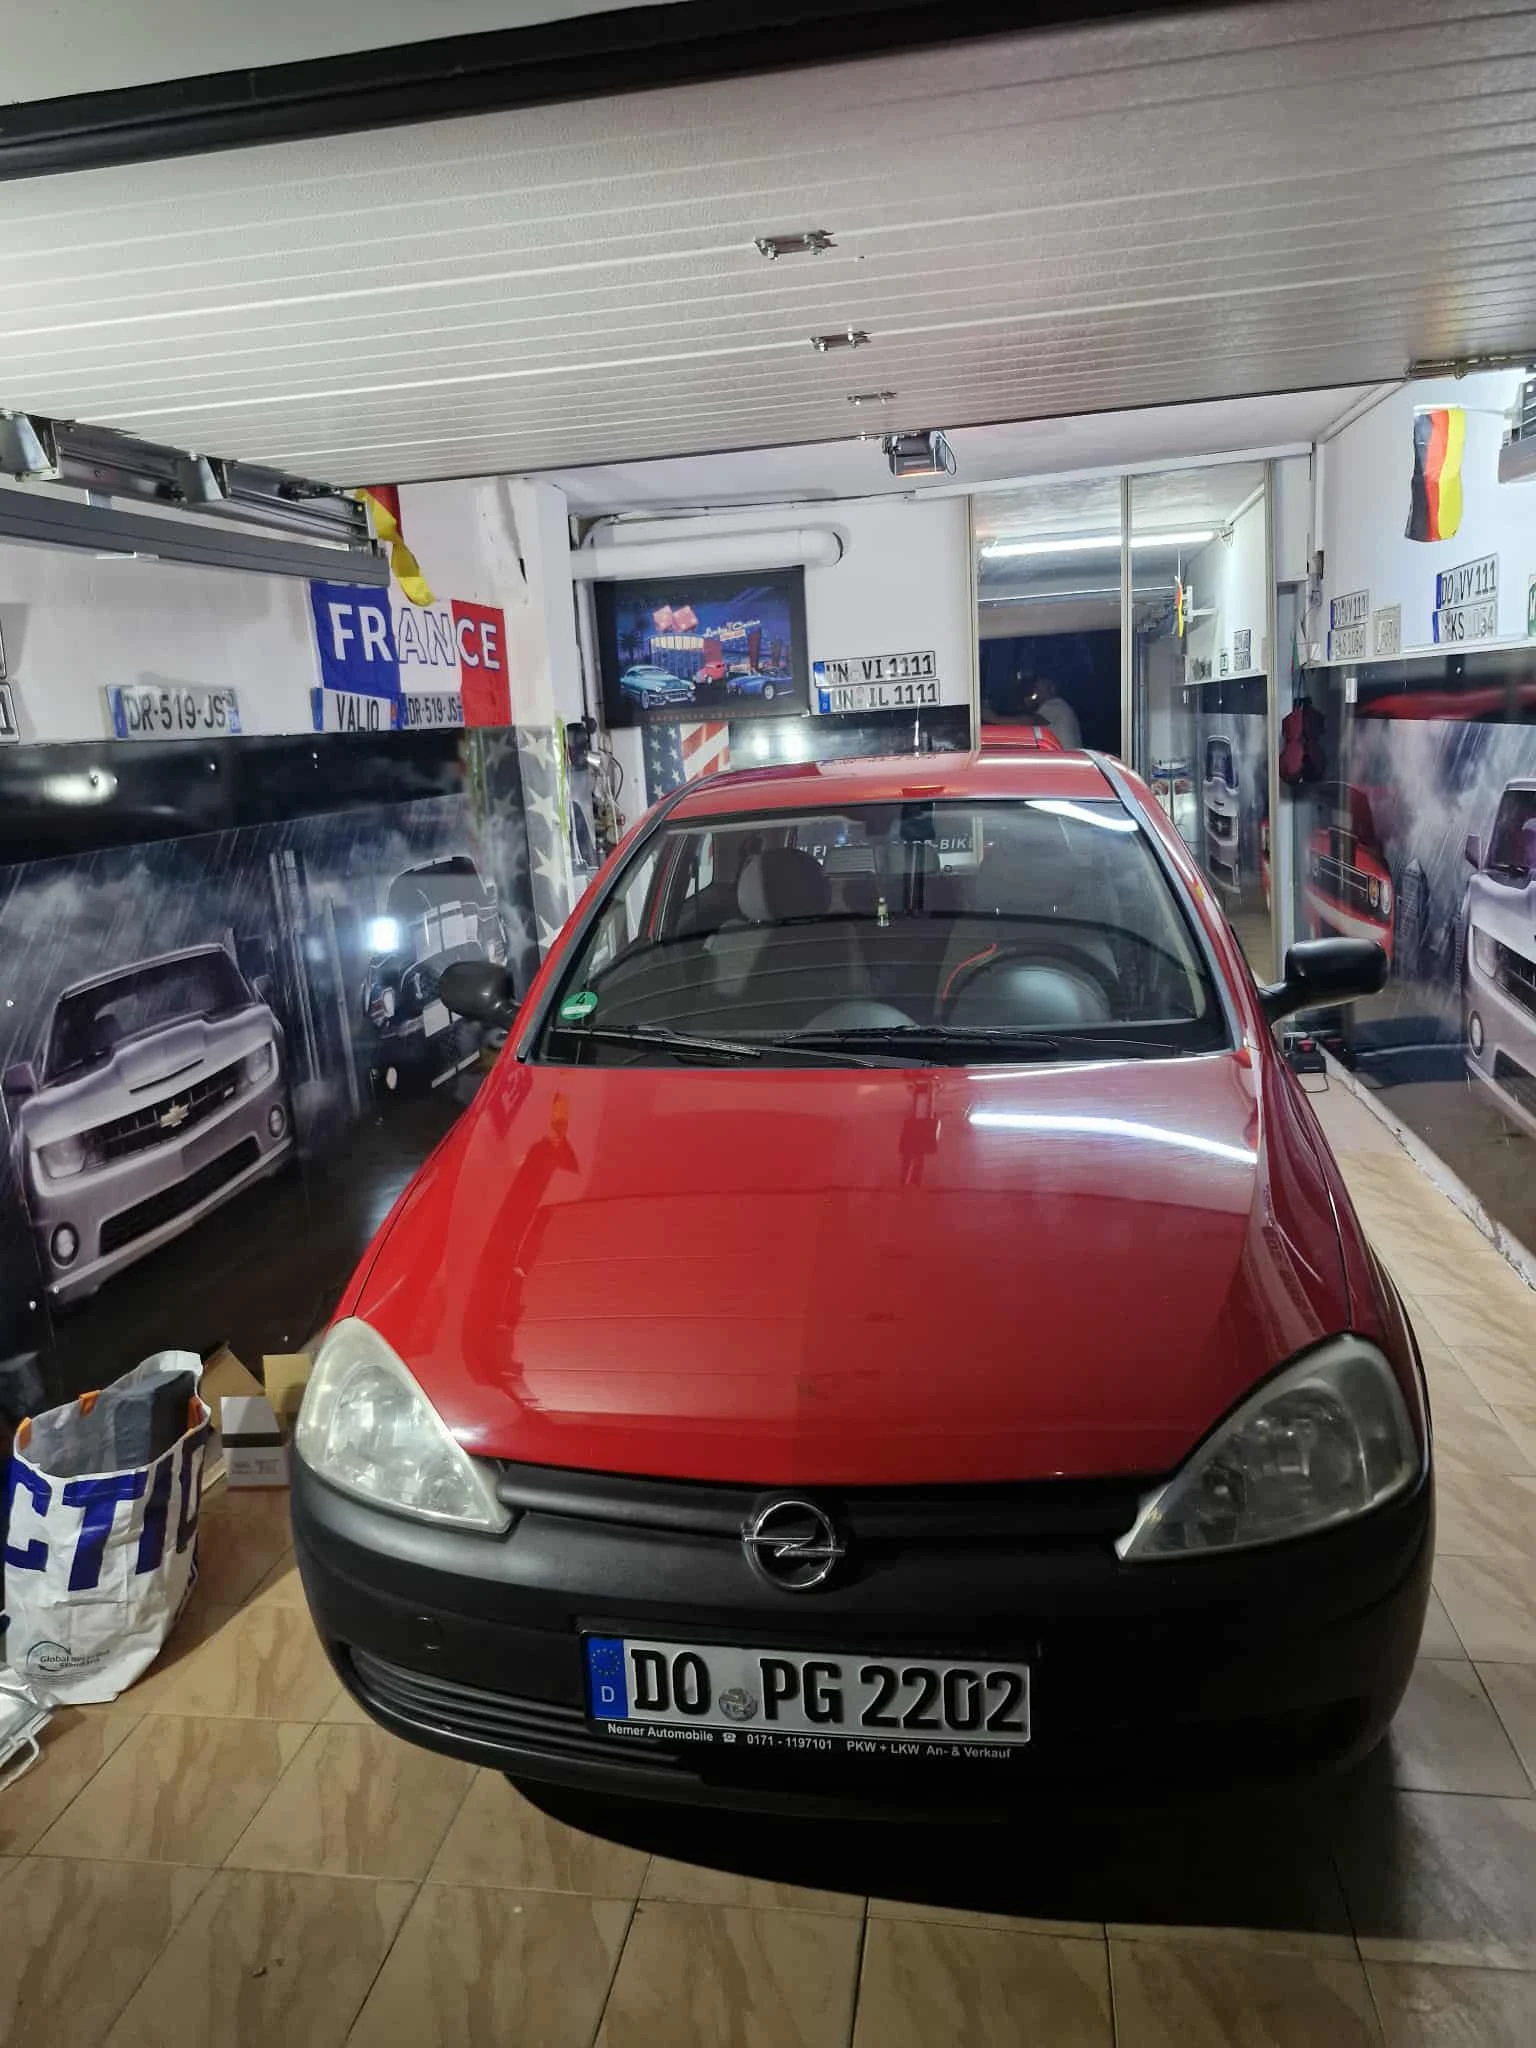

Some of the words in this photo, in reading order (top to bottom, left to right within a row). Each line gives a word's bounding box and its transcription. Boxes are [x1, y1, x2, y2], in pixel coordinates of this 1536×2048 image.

[1475, 560, 1496, 594] 111
[328, 602, 501, 671] FRANCE
[889, 654, 933, 678] 1111
[894, 683, 937, 705] 1111
[124, 693, 226, 731] DR-519-JS
[575, 992, 587, 1005] 4
[601, 1685, 615, 1703] D
[631, 1649, 711, 1715] DO
[759, 1658, 843, 1724] PG
[859, 1664, 1025, 1732] 2202
[607, 1723, 645, 1737] Nemer
[647, 1726, 714, 1742] Automobile
[746, 1734, 774, 1747] 0171
[786, 1736, 833, 1750] 1197101
[846, 1740, 877, 1753] PKW
[890, 1743, 920, 1756] LKW
[964, 1746, 1011, 1760] Verkauf
